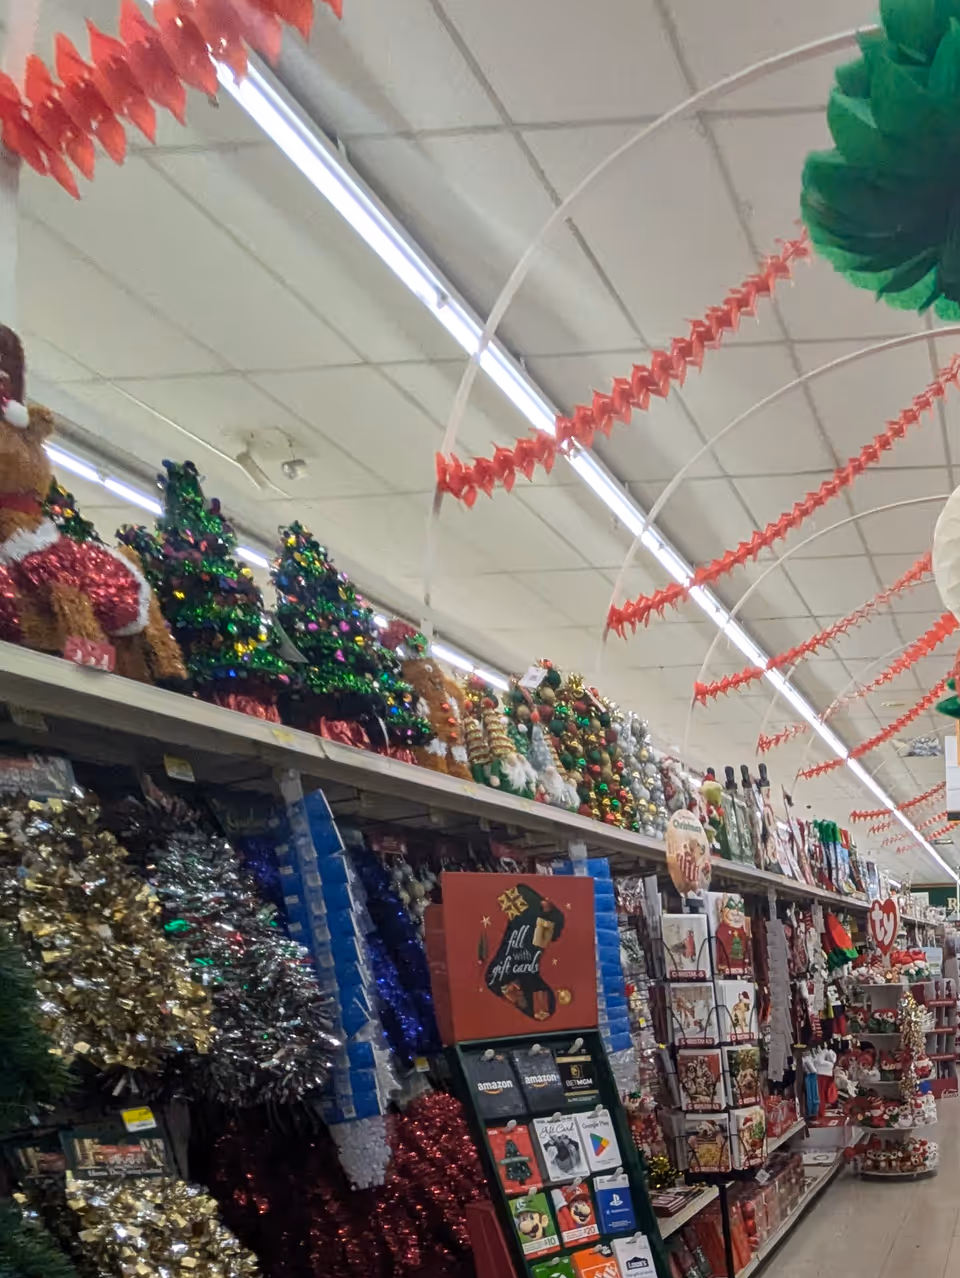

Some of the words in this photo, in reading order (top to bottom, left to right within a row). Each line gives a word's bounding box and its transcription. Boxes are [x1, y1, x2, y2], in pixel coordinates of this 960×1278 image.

[872, 903, 895, 945] ty
[505, 925, 530, 956] fill
[512, 949, 532, 961] with
[489, 956, 512, 985] gift
[512, 950, 542, 974] cards
[525, 1073, 558, 1085] amazon
[565, 1077, 594, 1088] BETMGM
[477, 1079, 513, 1092] amazon
[554, 1121, 576, 1135] Card
[583, 1225, 596, 1236] $20
[544, 1237, 556, 1247] $10
